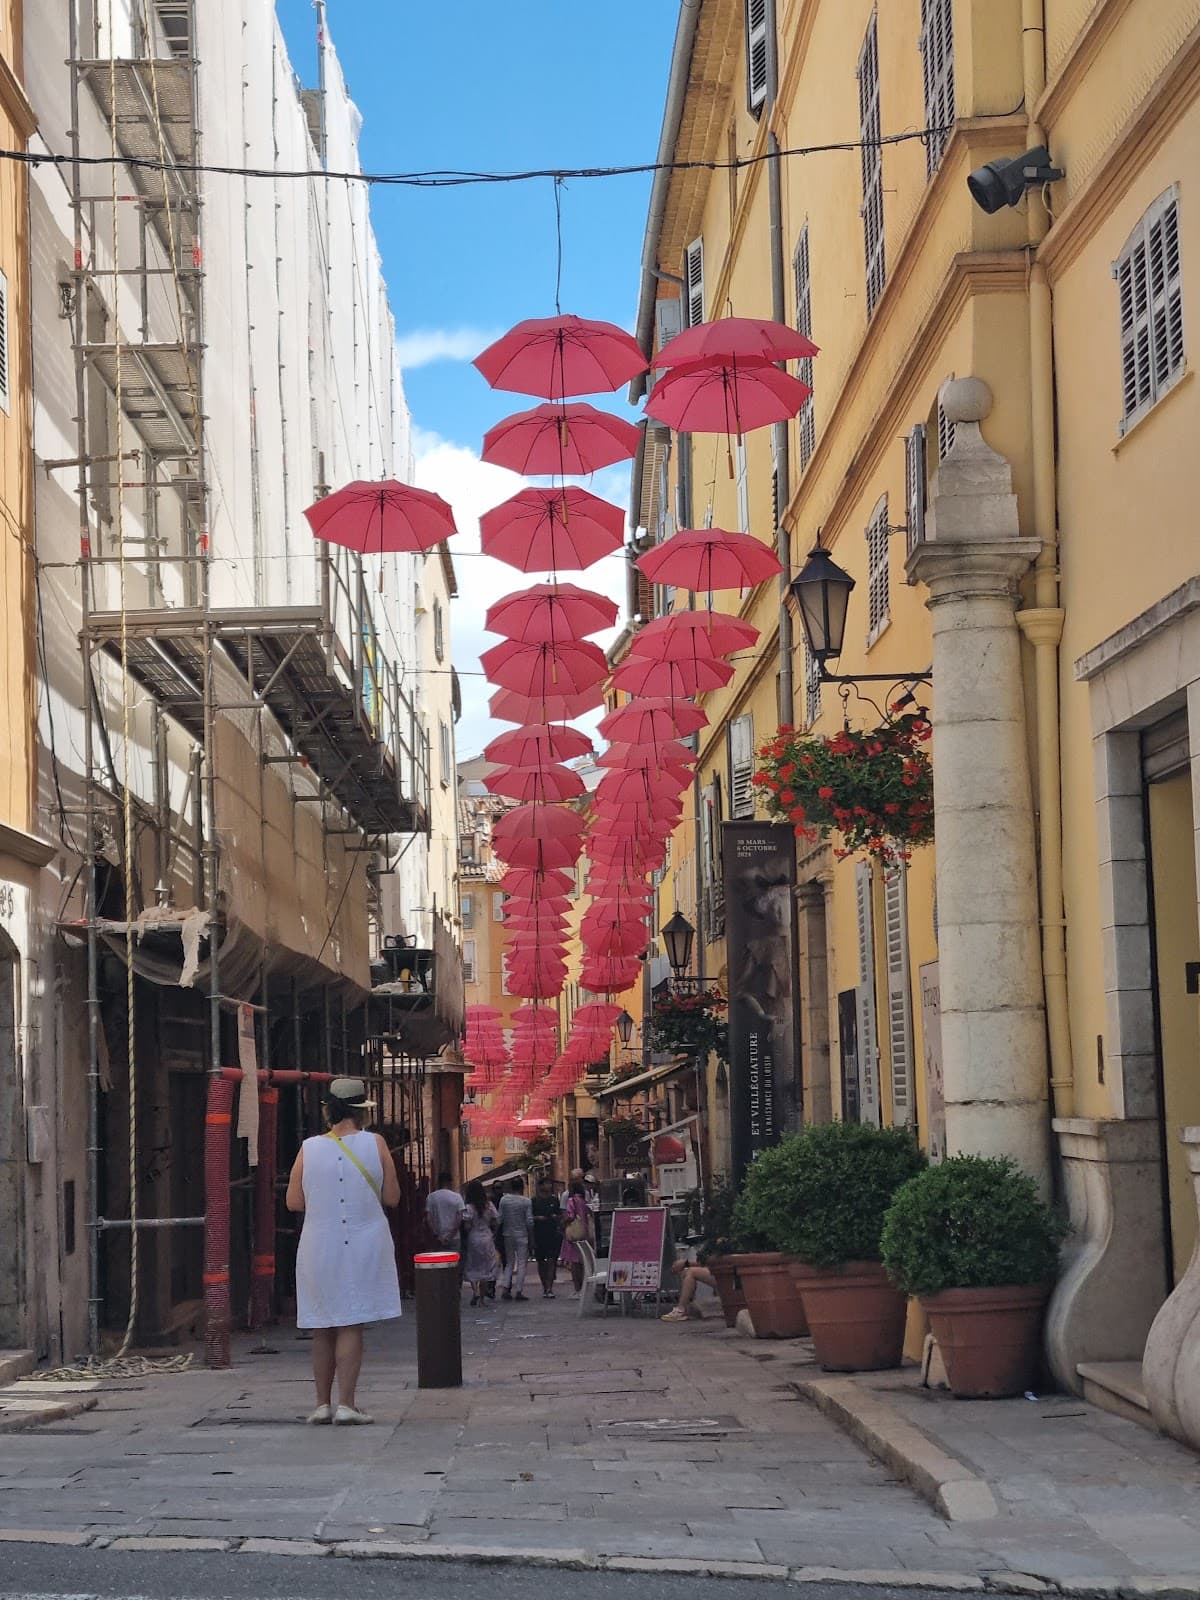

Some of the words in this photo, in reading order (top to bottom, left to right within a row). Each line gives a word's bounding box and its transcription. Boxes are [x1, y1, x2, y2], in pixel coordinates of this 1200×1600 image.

[764, 1079, 772, 1088] DU
[765, 1091, 773, 1125] NAISSANCE
[751, 1121, 760, 1136] ET
[765, 1126, 773, 1136] LA
